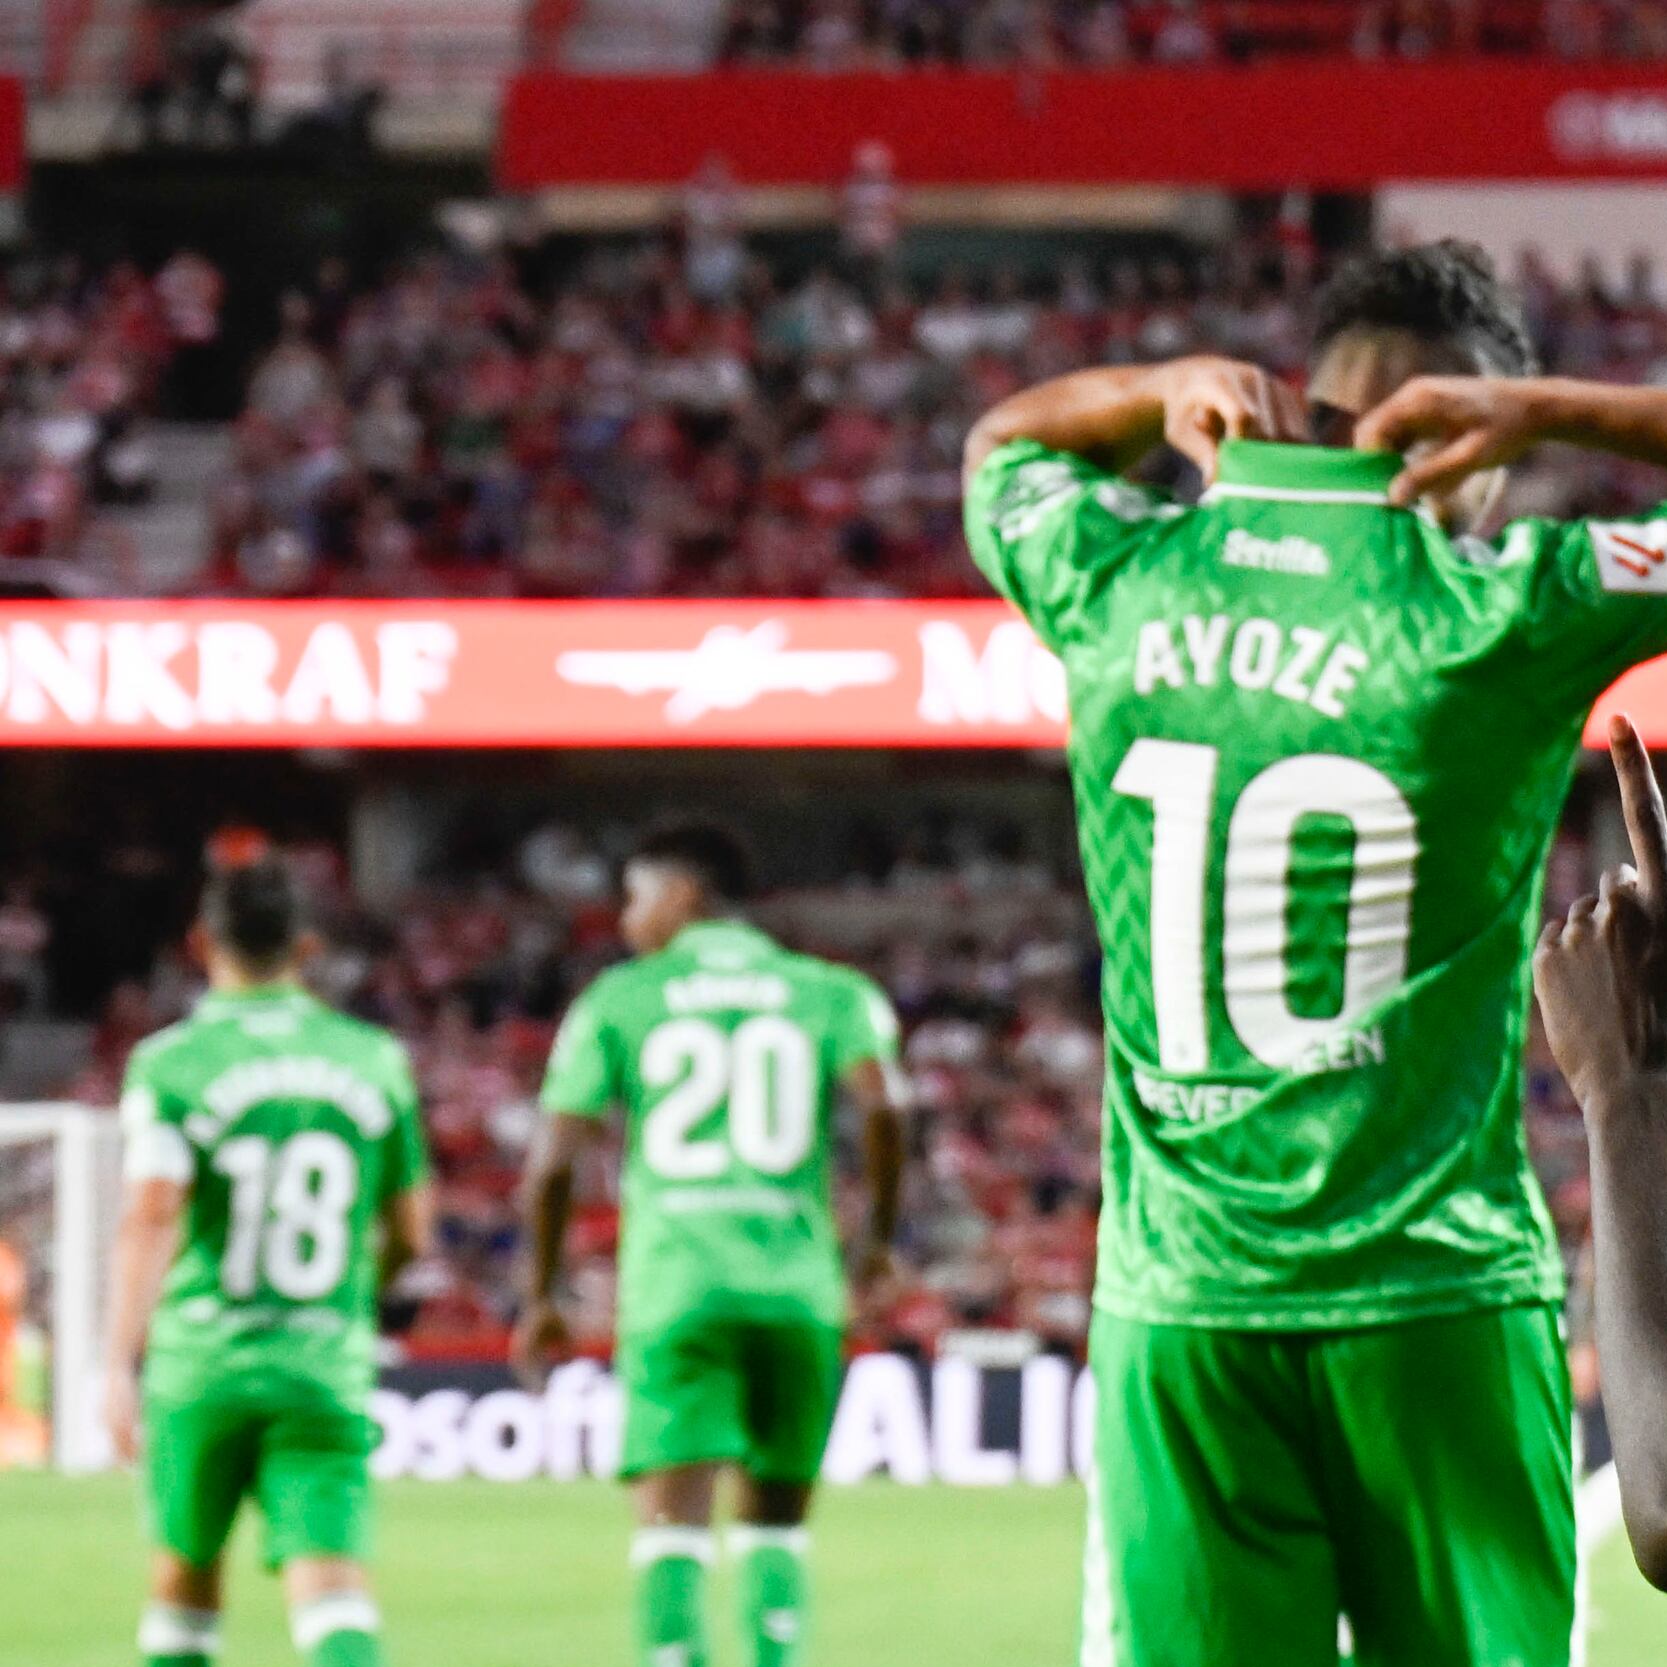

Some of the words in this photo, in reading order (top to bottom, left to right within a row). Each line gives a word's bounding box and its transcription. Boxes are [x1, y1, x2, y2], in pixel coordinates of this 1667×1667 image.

[0, 621, 458, 730] NKRAF
[1134, 614, 1370, 719] AYOZE
[1110, 737, 1419, 1074] 10
[639, 1015, 817, 1180] 20
[213, 1131, 358, 1301] 18
[821, 1352, 1096, 1486] ALI
